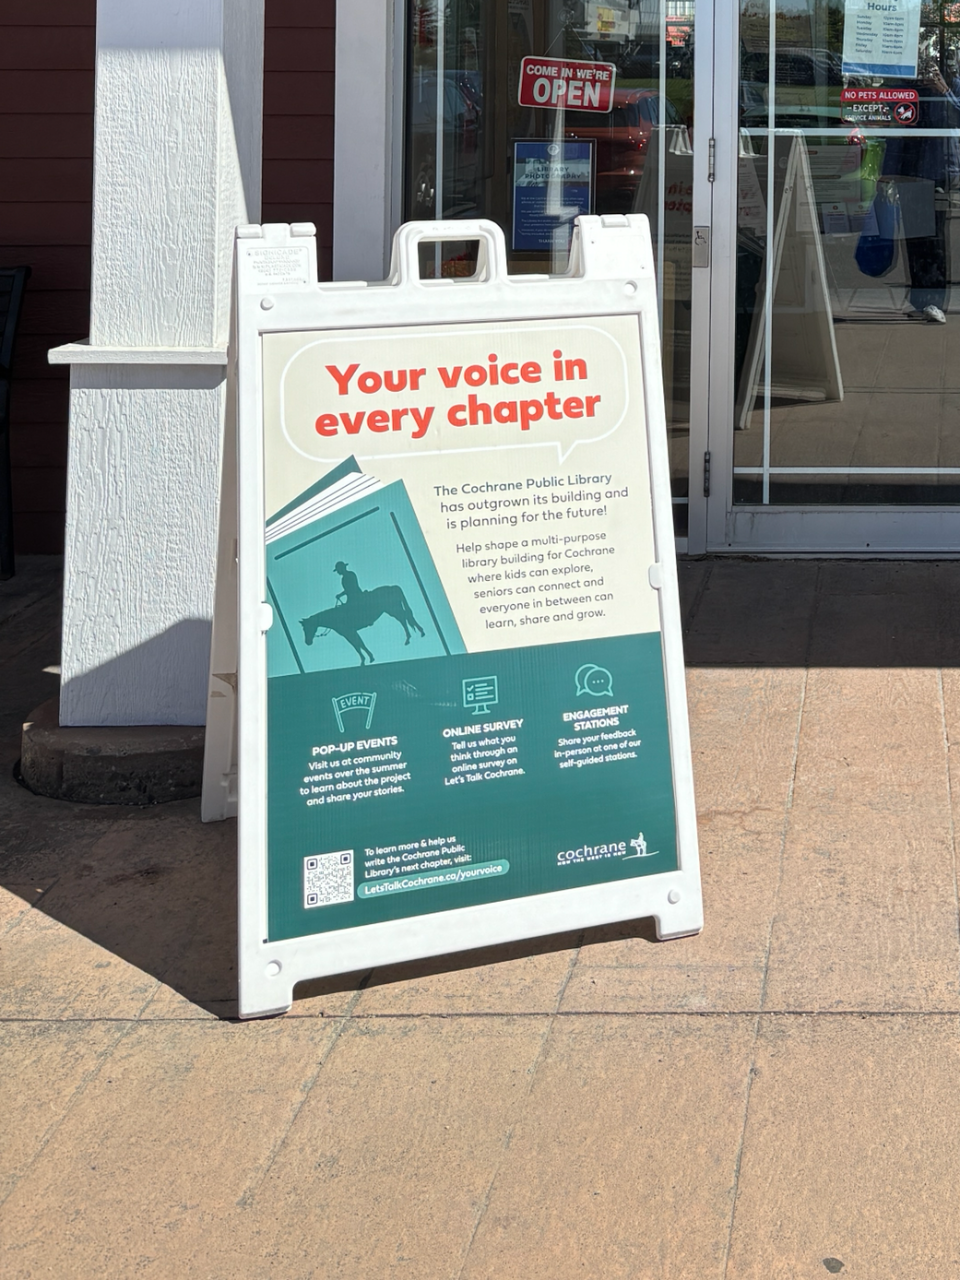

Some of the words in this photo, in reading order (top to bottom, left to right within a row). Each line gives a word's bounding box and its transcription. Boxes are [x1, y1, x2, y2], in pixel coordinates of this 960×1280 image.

[867, 2, 897, 12] Hours
[526, 64, 558, 77] COME
[561, 67, 573, 78] IN
[576, 68, 610, 80] WE'RE
[533, 77, 601, 107] OPEN
[858, 91, 877, 99] PETS
[879, 91, 915, 99] ALLOWED
[325, 363, 426, 396] Your
[437, 353, 542, 388] voice
[552, 349, 588, 381] in
[315, 406, 435, 439] every
[447, 391, 601, 431] chapter
[433, 485, 458, 497] The
[461, 481, 523, 495] Cochrane
[526, 476, 564, 489] Public
[567, 473, 612, 486] Library
[440, 502, 464, 513] has
[467, 496, 530, 512] outgrown
[533, 494, 548, 505] its
[551, 490, 602, 504] building
[604, 486, 629, 499] and
[446, 518, 457, 530] is
[460, 514, 518, 531] planning
[521, 512, 539, 523] for
[542, 509, 563, 521] the
[566, 505, 607, 519] future!
[456, 542, 482, 554] Help
[484, 540, 518, 551] shape
[531, 532, 607, 547] multi-purpose
[461, 557, 498, 569] library
[500, 553, 545, 565] building
[547, 549, 562, 560] for
[564, 545, 615, 559] Cochrane
[467, 571, 502, 584] where
[504, 569, 527, 580] kids
[529, 568, 549, 578] can
[551, 563, 594, 576] explore,
[473, 586, 513, 599] seniors
[515, 584, 536, 595] can
[538, 579, 581, 593] connect
[583, 576, 605, 587] and
[479, 600, 531, 614] everyone
[533, 598, 543, 608] in
[545, 595, 592, 607] between
[594, 592, 614, 602] can
[485, 619, 517, 629] learn,
[519, 614, 550, 626] share
[552, 610, 574, 622] and
[576, 608, 606, 621] grow.
[340, 696, 370, 709] EVENT
[562, 704, 629, 722] ENGAGEMENT
[442, 724, 482, 738] ONLINE
[483, 718, 524, 733] SURVEY
[573, 717, 620, 731] STATIONS
[312, 741, 355, 757] POP-UP
[356, 735, 398, 751] EVENTS
[451, 740, 466, 751] Tell
[467, 740, 477, 749] us
[478, 736, 500, 747] what
[501, 735, 516, 746] you
[558, 737, 581, 747] Share
[582, 734, 600, 745] your
[600, 728, 637, 742] feedback
[450, 751, 472, 762] think
[473, 747, 506, 760] through
[505, 746, 518, 755] an
[554, 748, 592, 759] in-person
[593, 745, 602, 753] at
[603, 743, 618, 752] one
[619, 740, 628, 749] of
[628, 739, 642, 748] our
[308, 760, 328, 771] Visit
[330, 759, 340, 768] us
[341, 756, 352, 766] at
[353, 750, 402, 765] community
[451, 762, 477, 773] online
[479, 759, 505, 771] survey
[506, 757, 517, 765] on
[559, 754, 604, 769] self-guided
[605, 751, 638, 762] stations.
[303, 773, 333, 784] events
[334, 769, 354, 779] over
[355, 766, 370, 776] the
[371, 762, 408, 774] summer
[444, 774, 465, 786] Let's
[466, 771, 483, 782] Talk
[484, 766, 526, 780] Cochrane.
[299, 786, 310, 796] to
[311, 782, 335, 794] learn
[336, 778, 363, 790] about
[364, 776, 379, 786] the
[380, 772, 411, 785] project
[306, 795, 325, 807] and
[326, 792, 351, 804] share
[352, 791, 373, 802] your
[373, 785, 405, 796] stories.
[364, 847, 375, 857] To
[375, 845, 397, 856] learn
[398, 841, 420, 852] more
[420, 839, 428, 848] &
[428, 836, 446, 847] help
[446, 835, 457, 844] us
[364, 858, 386, 868] write
[387, 855, 400, 864] the
[401, 849, 440, 862] Cochrane
[441, 844, 466, 855] Public
[557, 841, 627, 861] cochrane
[364, 866, 400, 879] Library's
[401, 864, 419, 873] next
[420, 858, 453, 871] chapter,
[454, 854, 472, 864] visit:
[364, 864, 503, 895] LetsTalkCochrane.ca/yourvoice
